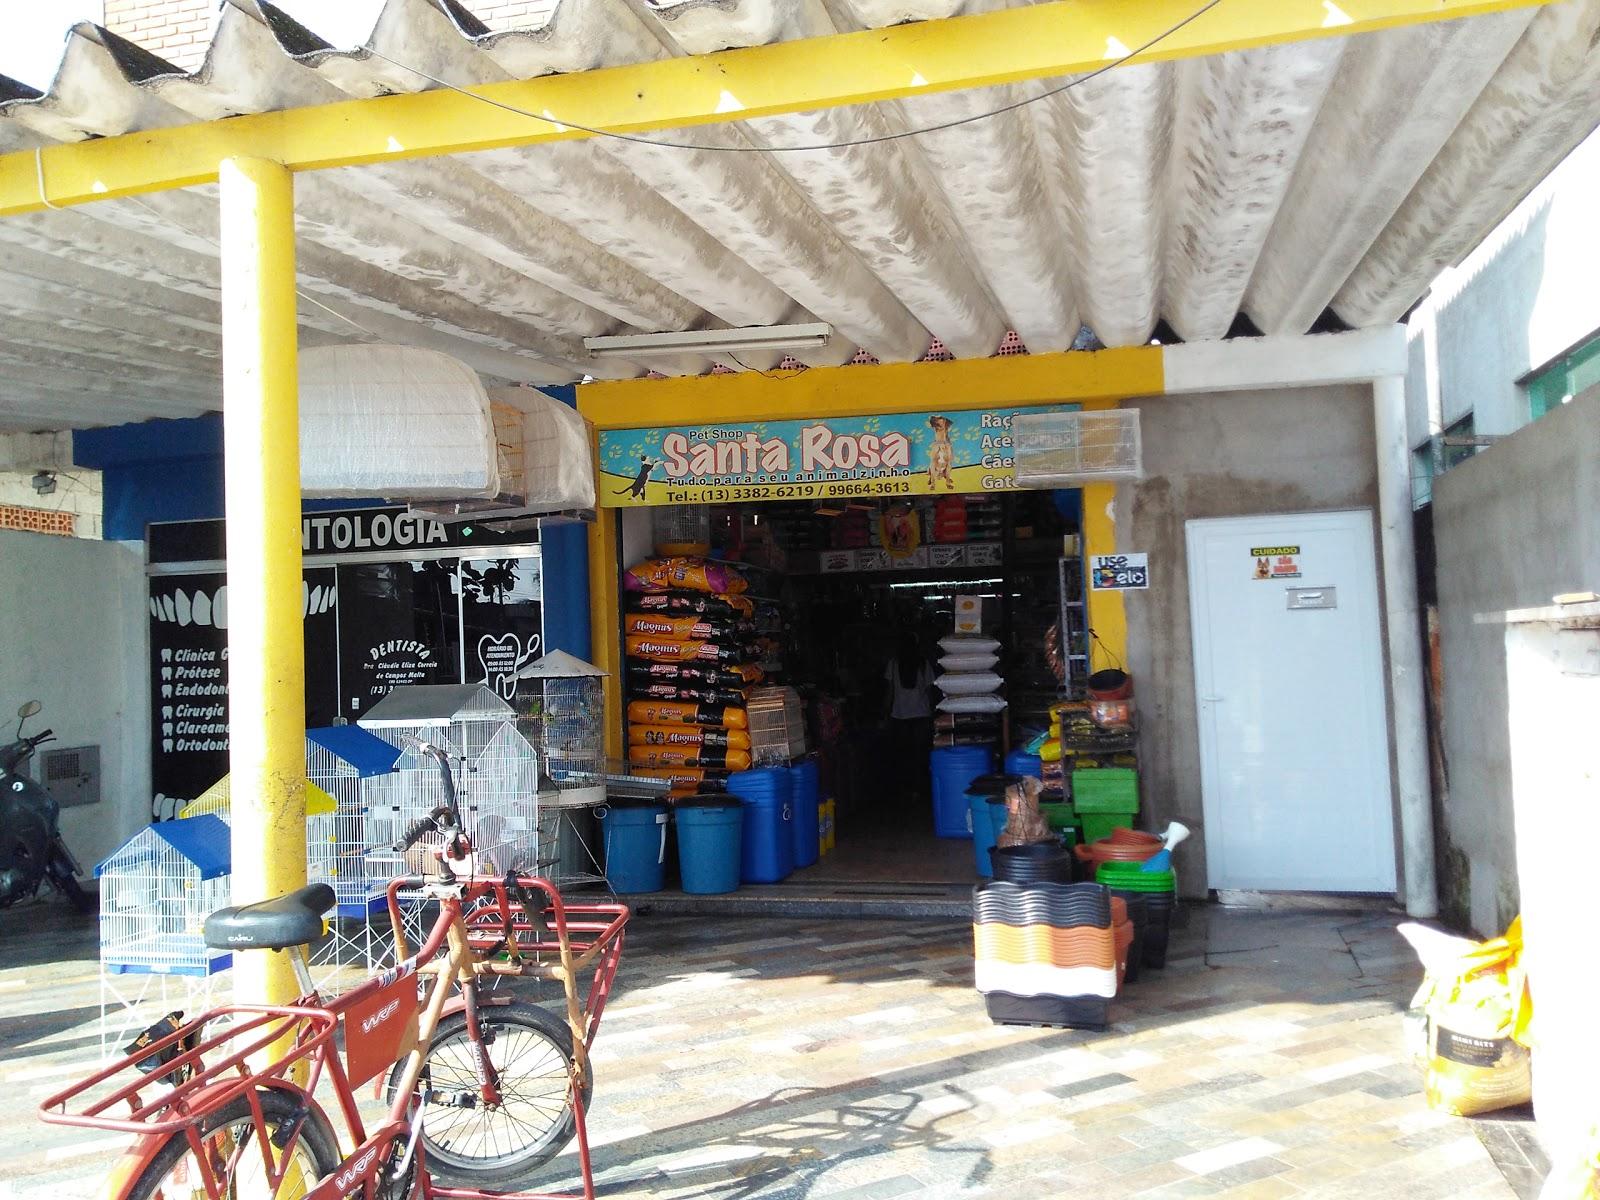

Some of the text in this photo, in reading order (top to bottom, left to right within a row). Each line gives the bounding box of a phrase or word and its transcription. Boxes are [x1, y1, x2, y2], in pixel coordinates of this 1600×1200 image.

[689, 429, 743, 440] Pet Shop
[663, 423, 910, 477] Santa Rosa
[667, 467, 910, 487] Tudo para seu animalzinho
[667, 491, 698, 502] Tel.:
[701, 489, 730, 502] (13)
[733, 485, 814, 499] 3382-6219
[829, 482, 910, 496] 99664-3613
[1252, 547, 1297, 556] CUIDADO
[1098, 555, 1128, 569] use
[632, 620, 673, 634] Magnus
[370, 640, 431, 660] DENTISTA
[637, 642, 679, 655] Magnus
[175, 666, 221, 679] Prótese
[370, 685, 387, 696] (13)
[176, 703, 225, 720] Cirurgia
[668, 732, 703, 744] Magnus
[669, 774, 697, 783] Magnus
[335, 1146, 377, 1191] WRP
